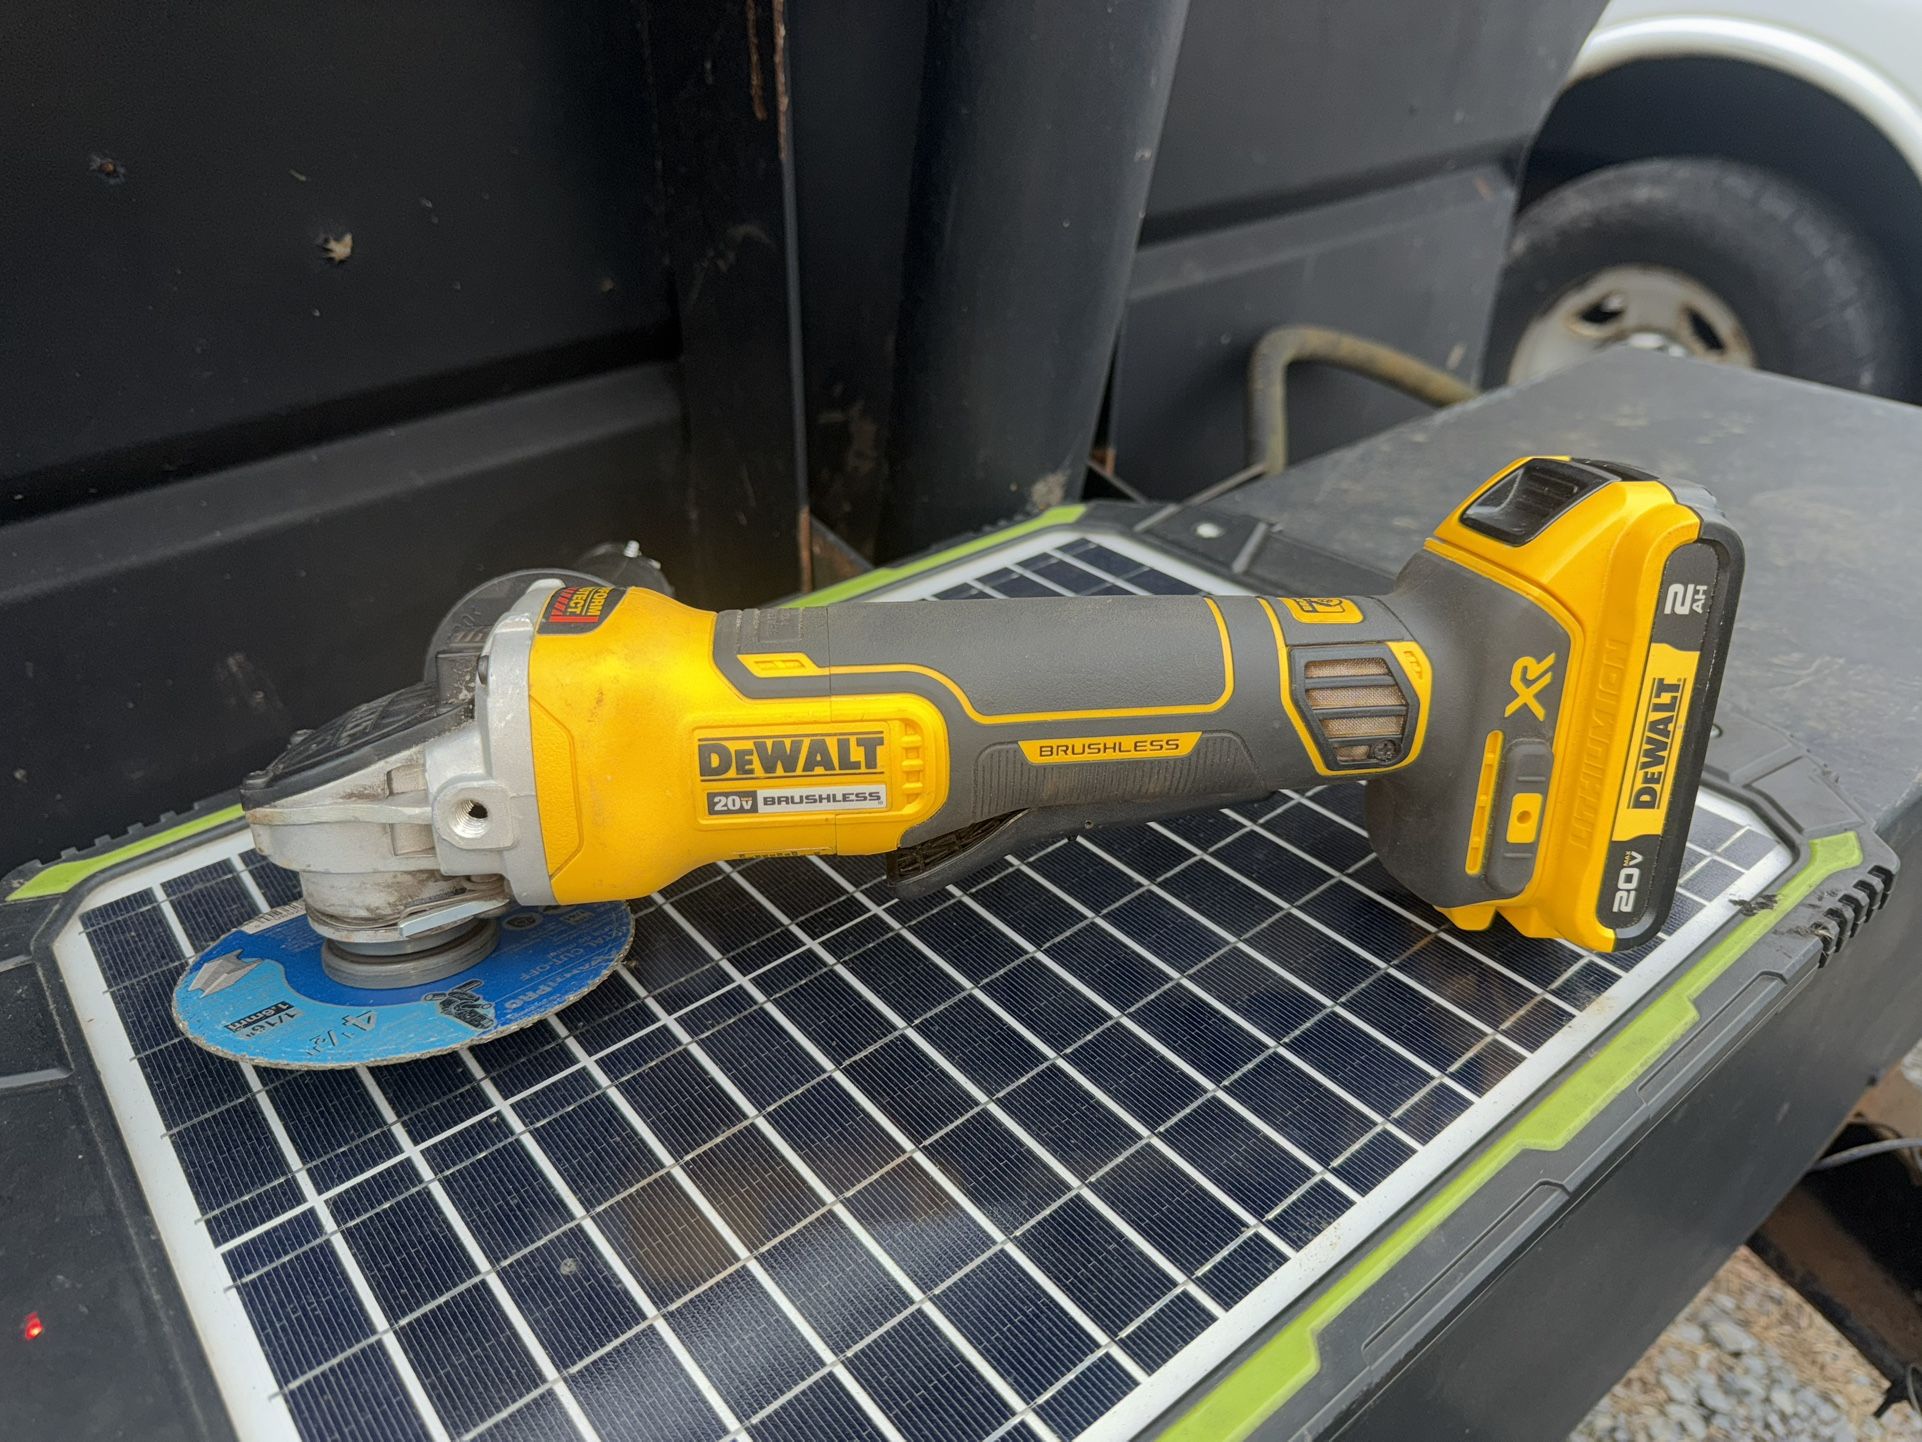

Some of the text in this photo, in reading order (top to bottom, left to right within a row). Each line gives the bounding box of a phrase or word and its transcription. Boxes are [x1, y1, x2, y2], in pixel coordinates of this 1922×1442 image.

[1664, 584, 1695, 614] 2
[1692, 585, 1708, 614] AH
[1505, 652, 1556, 721] XR
[698, 737, 884, 777] DEWALT
[1039, 739, 1180, 758] BRUSHLESS
[1570, 639, 1628, 849] LITHIUM ION
[1632, 678, 1682, 809] DEWALT
[763, 792, 881, 806] BRUSHLESS
[1613, 850, 1644, 913] 20V
